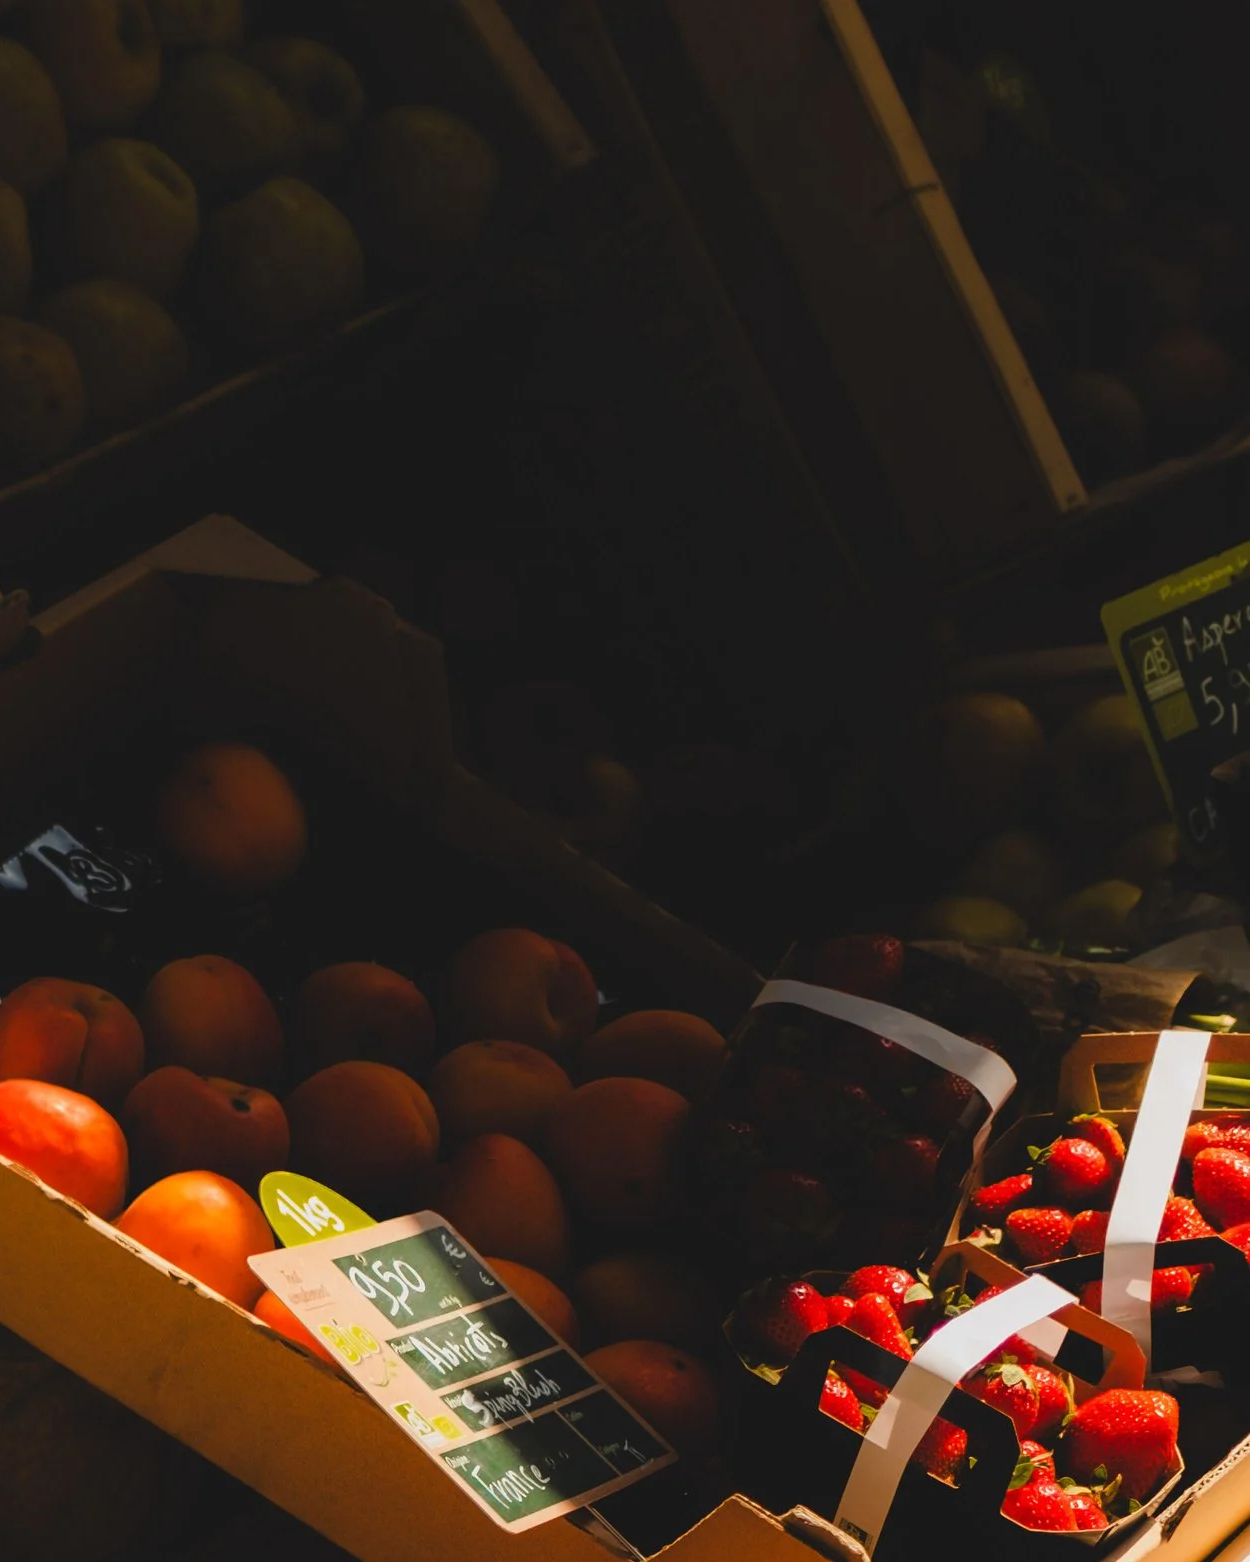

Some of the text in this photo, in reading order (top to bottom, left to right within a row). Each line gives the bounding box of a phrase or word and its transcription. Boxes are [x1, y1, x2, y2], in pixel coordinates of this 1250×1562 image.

[276, 1189, 345, 1237] 1kg
[318, 1318, 382, 1366] Bio
[408, 1312, 508, 1375] Abricots
[472, 1463, 551, 1509] France
